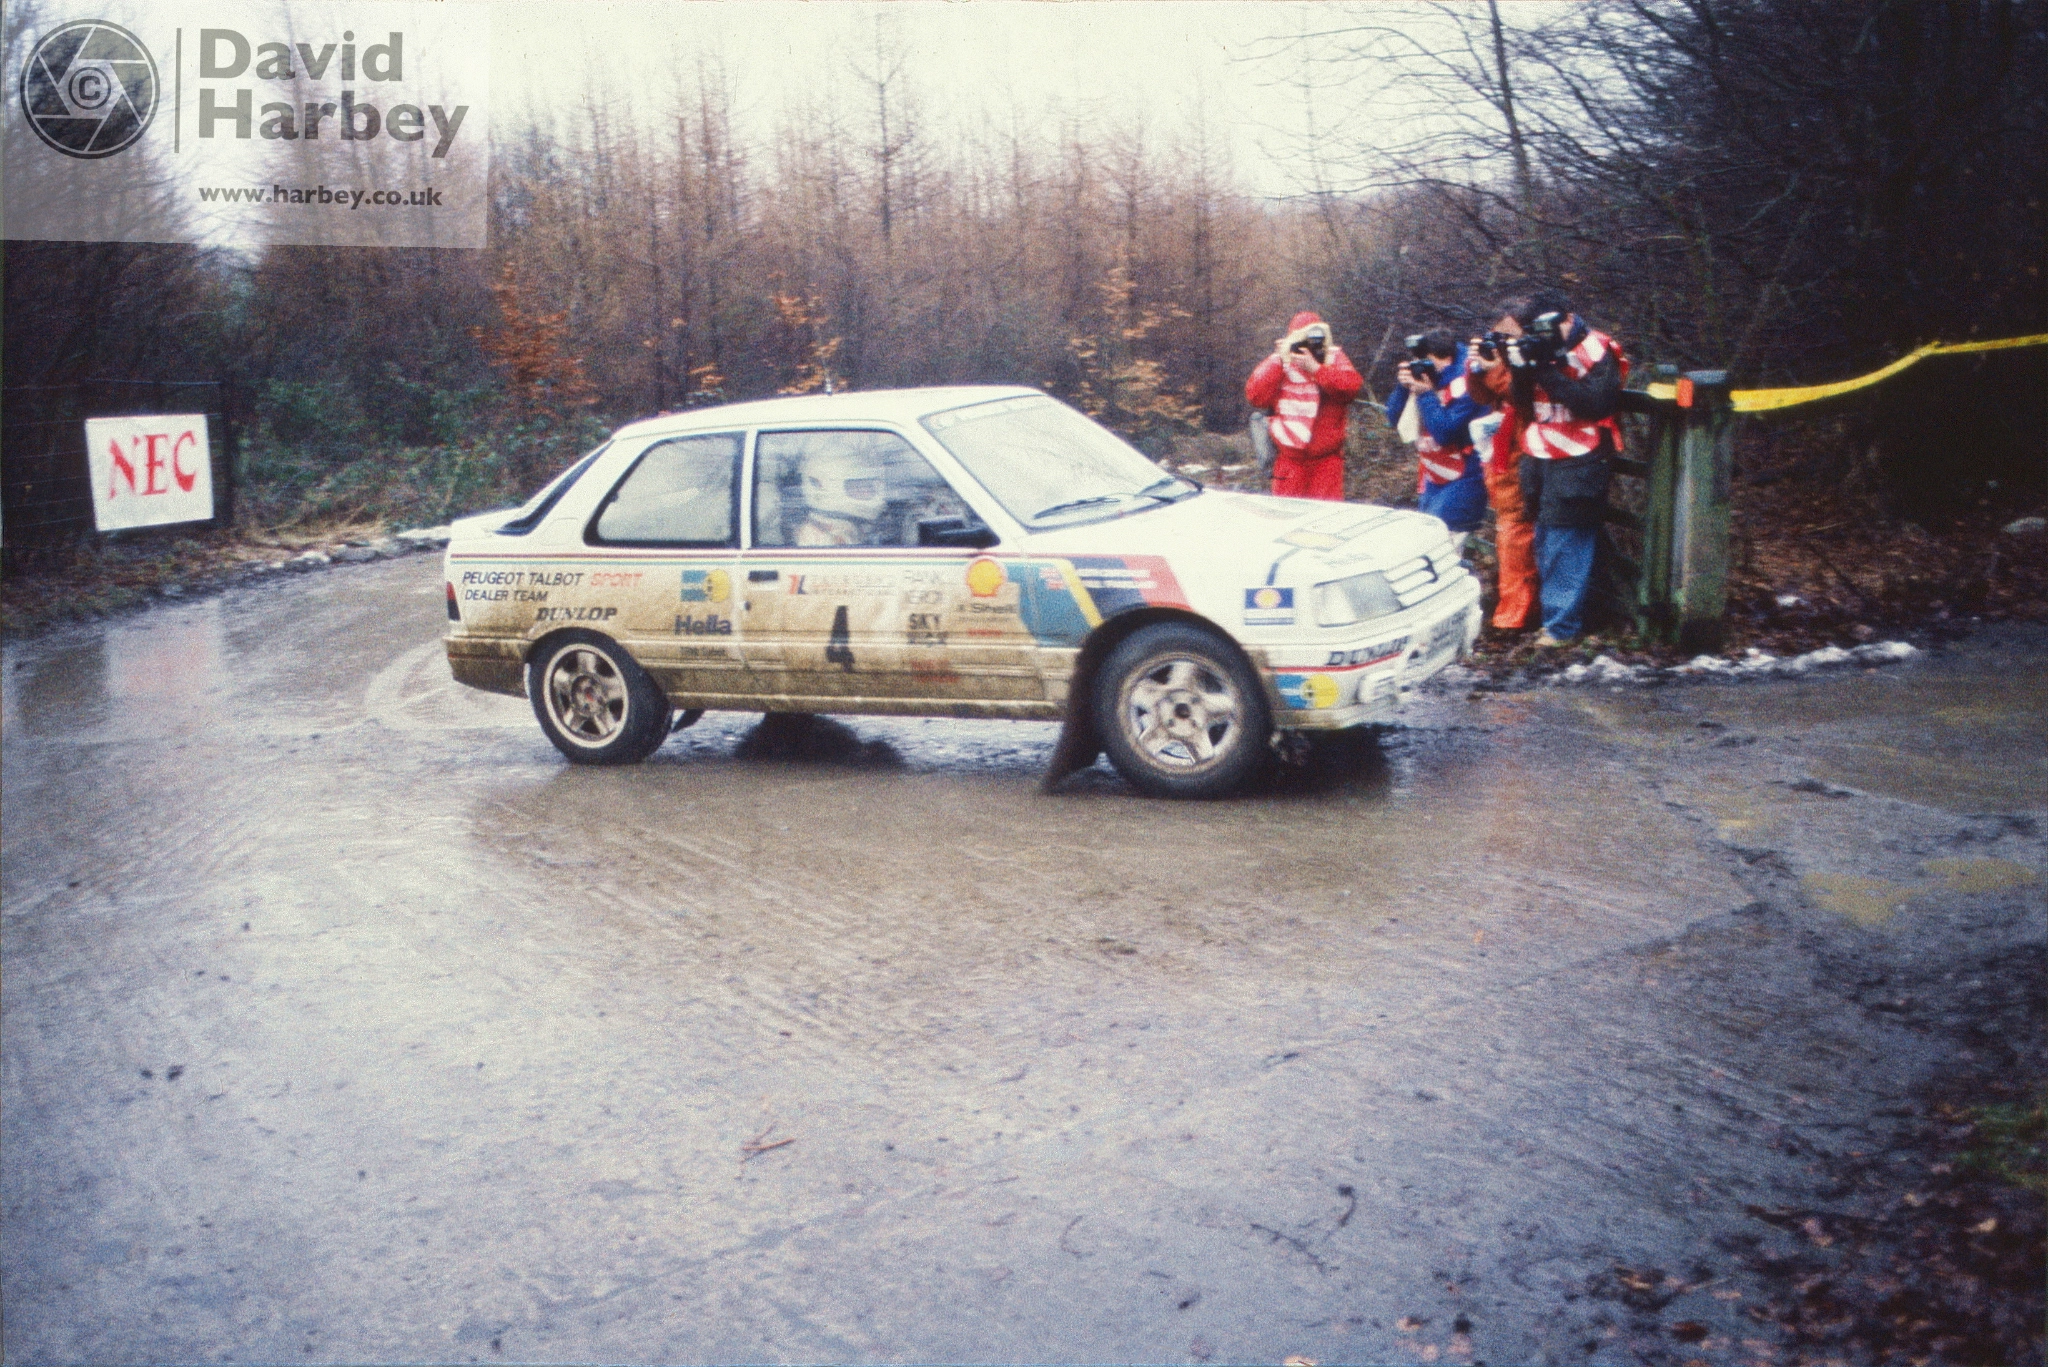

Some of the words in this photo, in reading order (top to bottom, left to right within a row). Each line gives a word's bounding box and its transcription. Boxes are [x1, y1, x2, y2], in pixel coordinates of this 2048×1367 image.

[109, 430, 196, 499] NEC
[462, 571, 524, 585] PEUGEOT
[528, 572, 585, 586] TALBOT
[465, 589, 508, 600] DEALER
[512, 590, 549, 602] TEAM
[535, 607, 618, 621] DUNLOP
[674, 614, 732, 636] Hella
